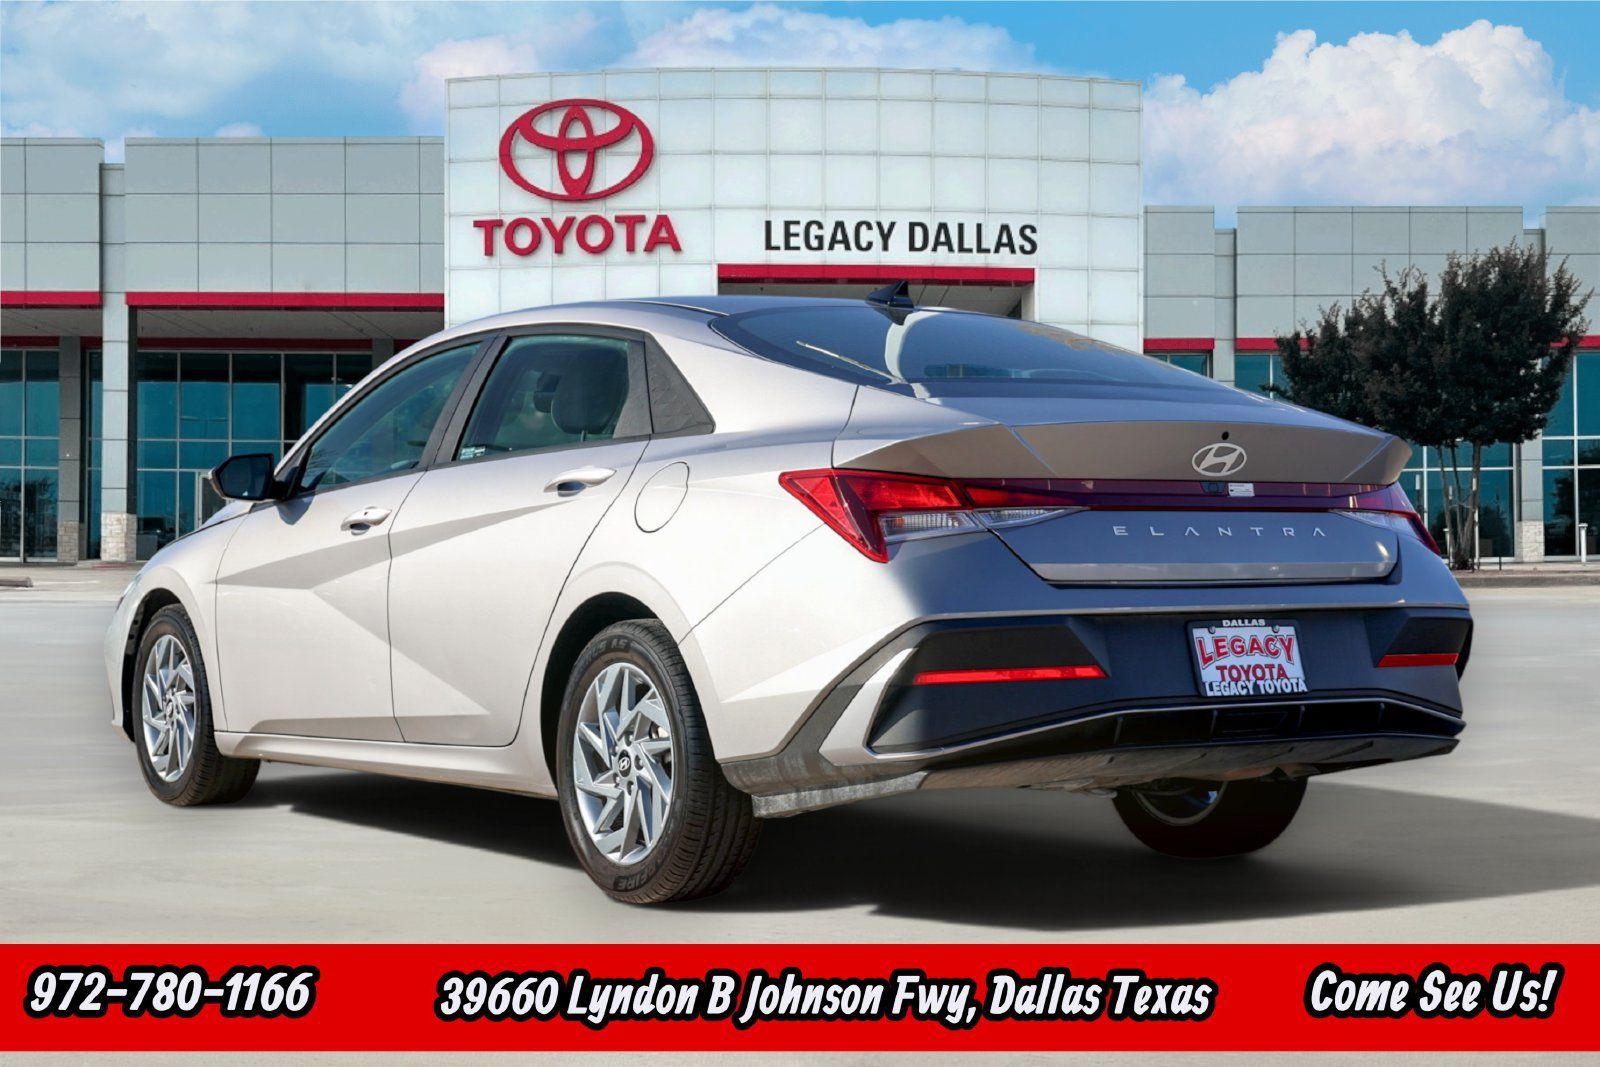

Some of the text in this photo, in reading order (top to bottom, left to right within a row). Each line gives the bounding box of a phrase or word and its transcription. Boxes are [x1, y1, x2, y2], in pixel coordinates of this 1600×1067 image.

[474, 214, 682, 257] TOYOTA
[765, 219, 1038, 255] LEGACY DALLAS
[1112, 525, 1327, 537] ELANTRA
[1222, 619, 1265, 627] DALLAS
[1196, 635, 1295, 670] LEGACY
[1216, 663, 1289, 683] TOYOTA
[1205, 676, 1308, 697] LEGACY TOYOTA
